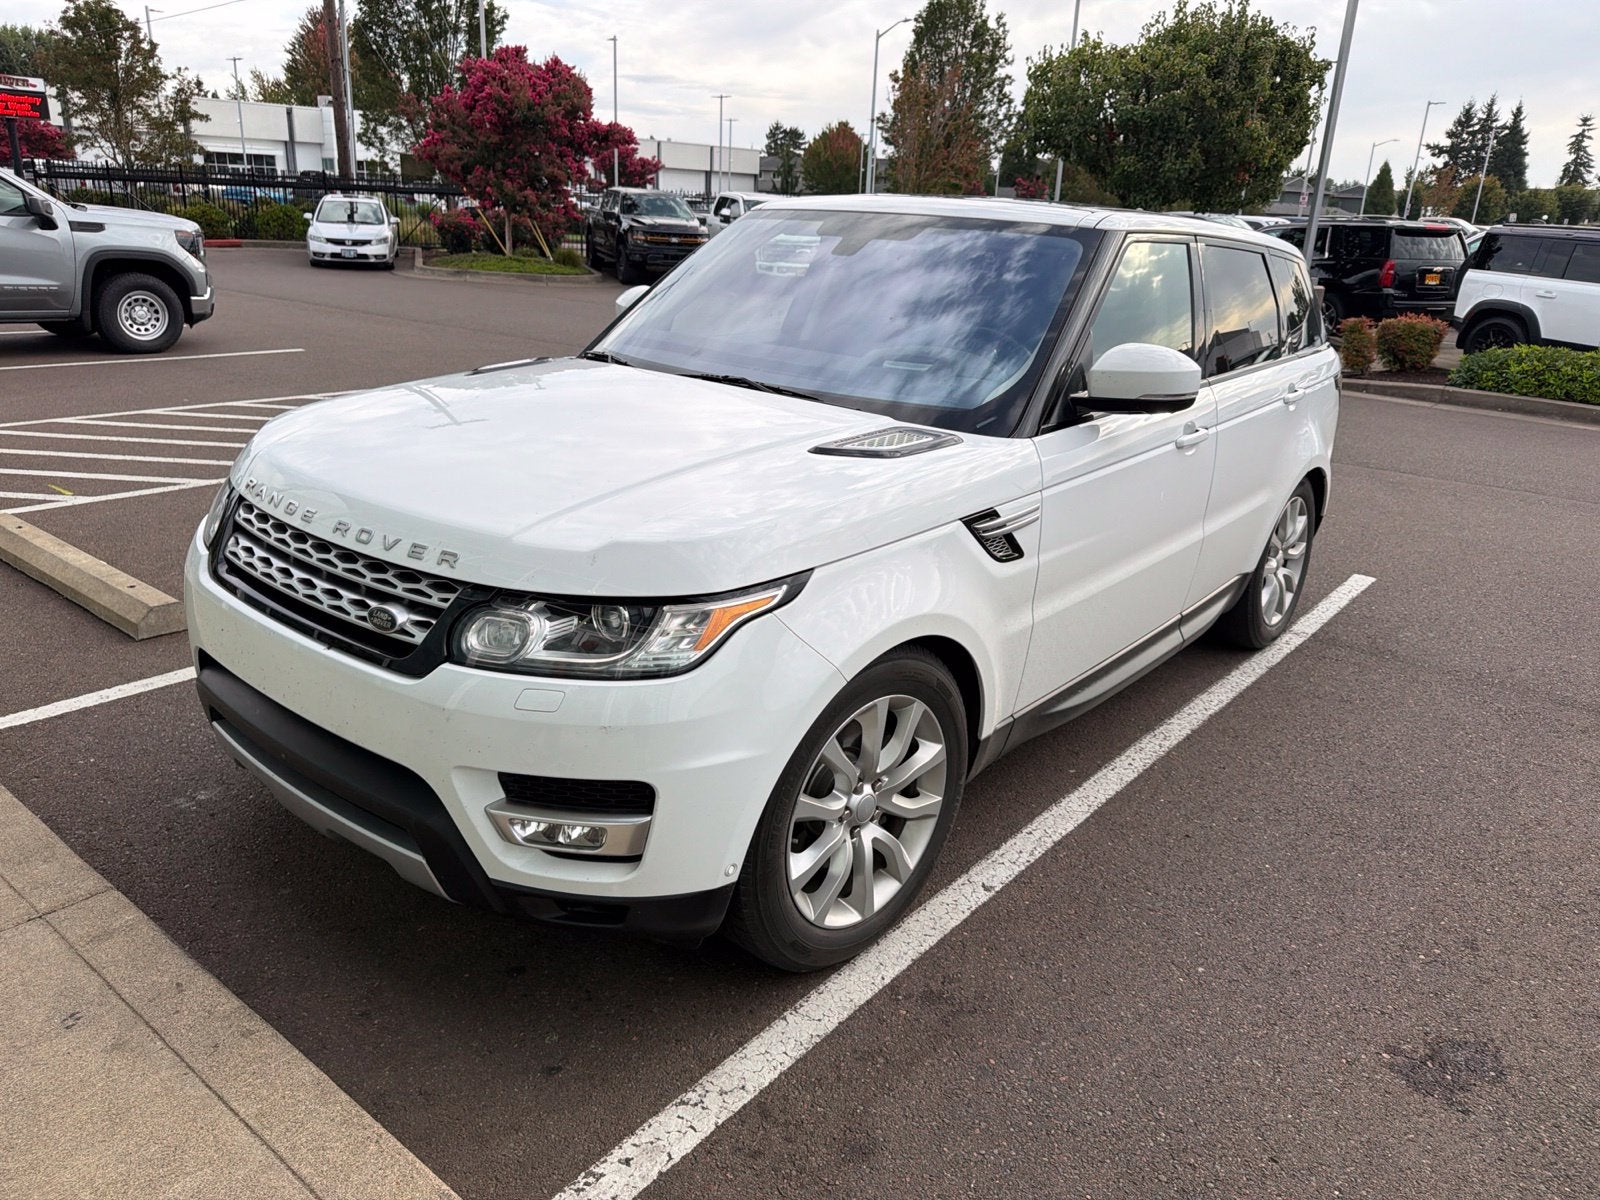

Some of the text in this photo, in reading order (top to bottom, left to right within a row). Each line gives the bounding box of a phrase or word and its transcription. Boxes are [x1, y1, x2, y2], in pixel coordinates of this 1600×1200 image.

[244, 476, 461, 569] RANGE ROVER
[372, 609, 389, 620] LAND
[373, 617, 392, 629] ROVER
